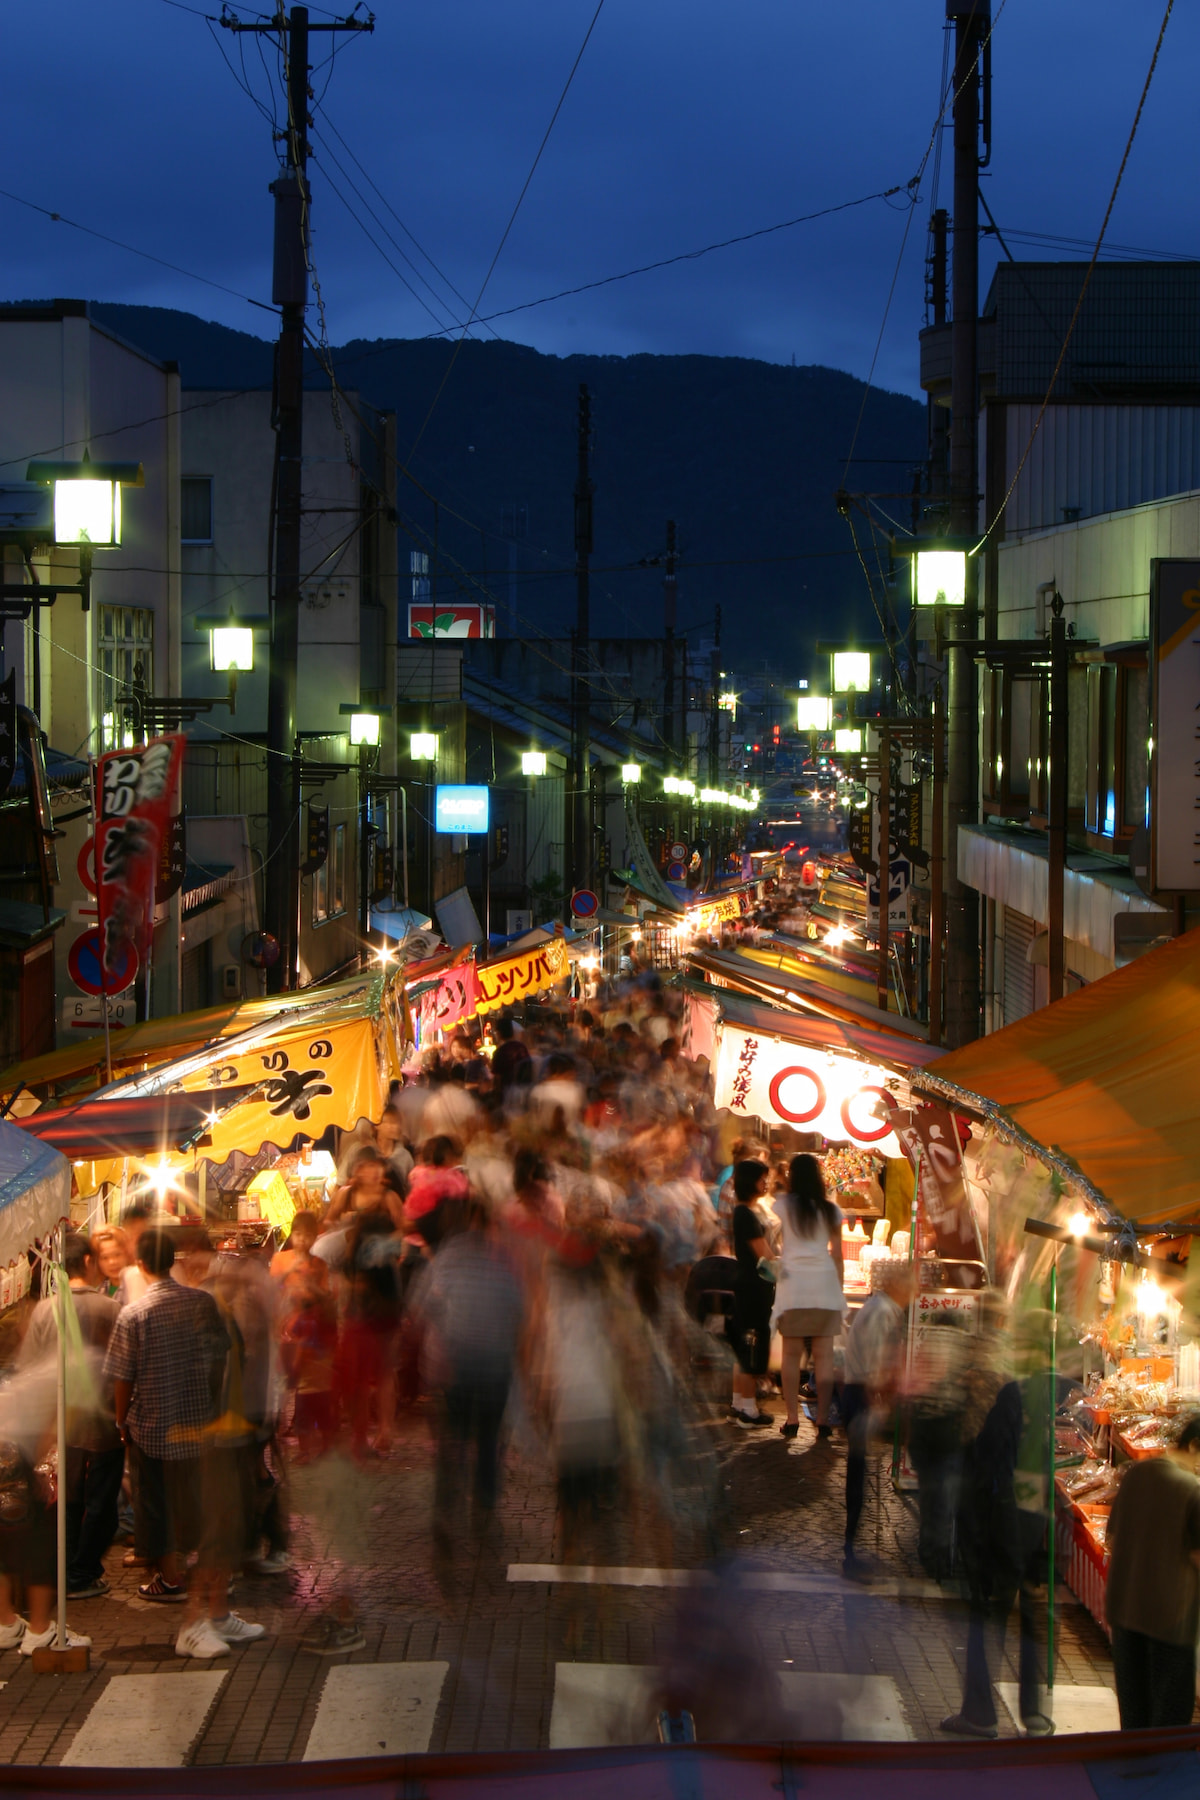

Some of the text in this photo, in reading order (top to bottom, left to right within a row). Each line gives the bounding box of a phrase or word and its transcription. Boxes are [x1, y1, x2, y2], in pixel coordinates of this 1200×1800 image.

[673, 847, 684, 856] 30
[872, 910, 906, 920] 宮文具
